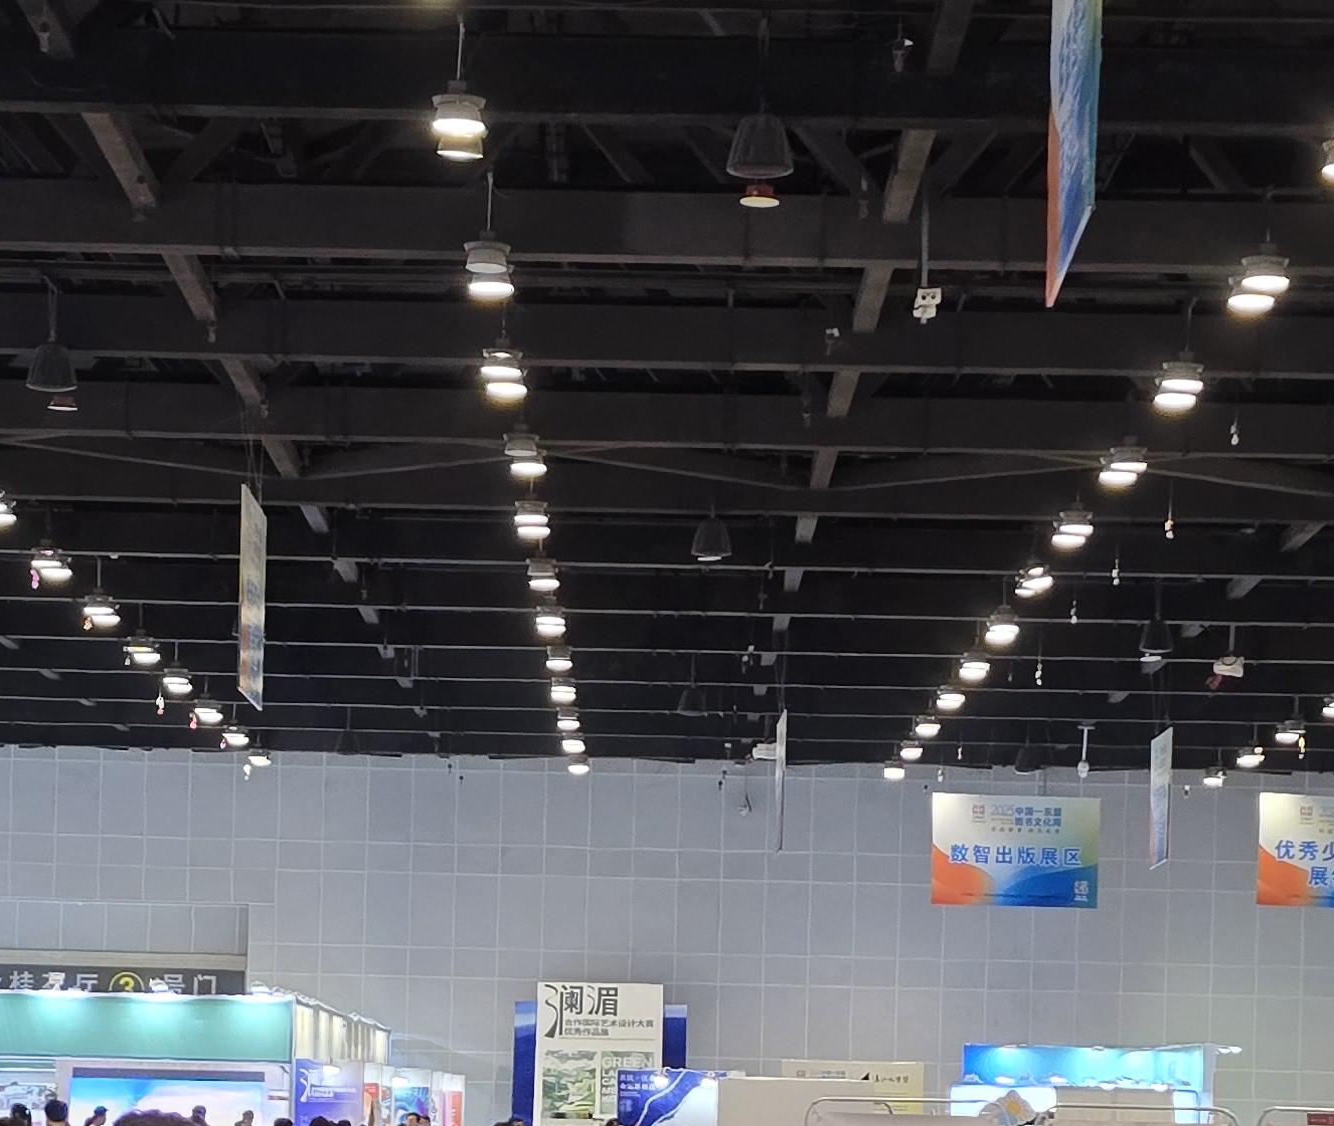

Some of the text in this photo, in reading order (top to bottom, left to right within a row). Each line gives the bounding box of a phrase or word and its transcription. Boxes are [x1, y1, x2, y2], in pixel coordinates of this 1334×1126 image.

[950, 843, 1081, 866] 数智出版展区
[544, 984, 619, 1038] 澜湄
[602, 1057, 653, 1068] GREEN
